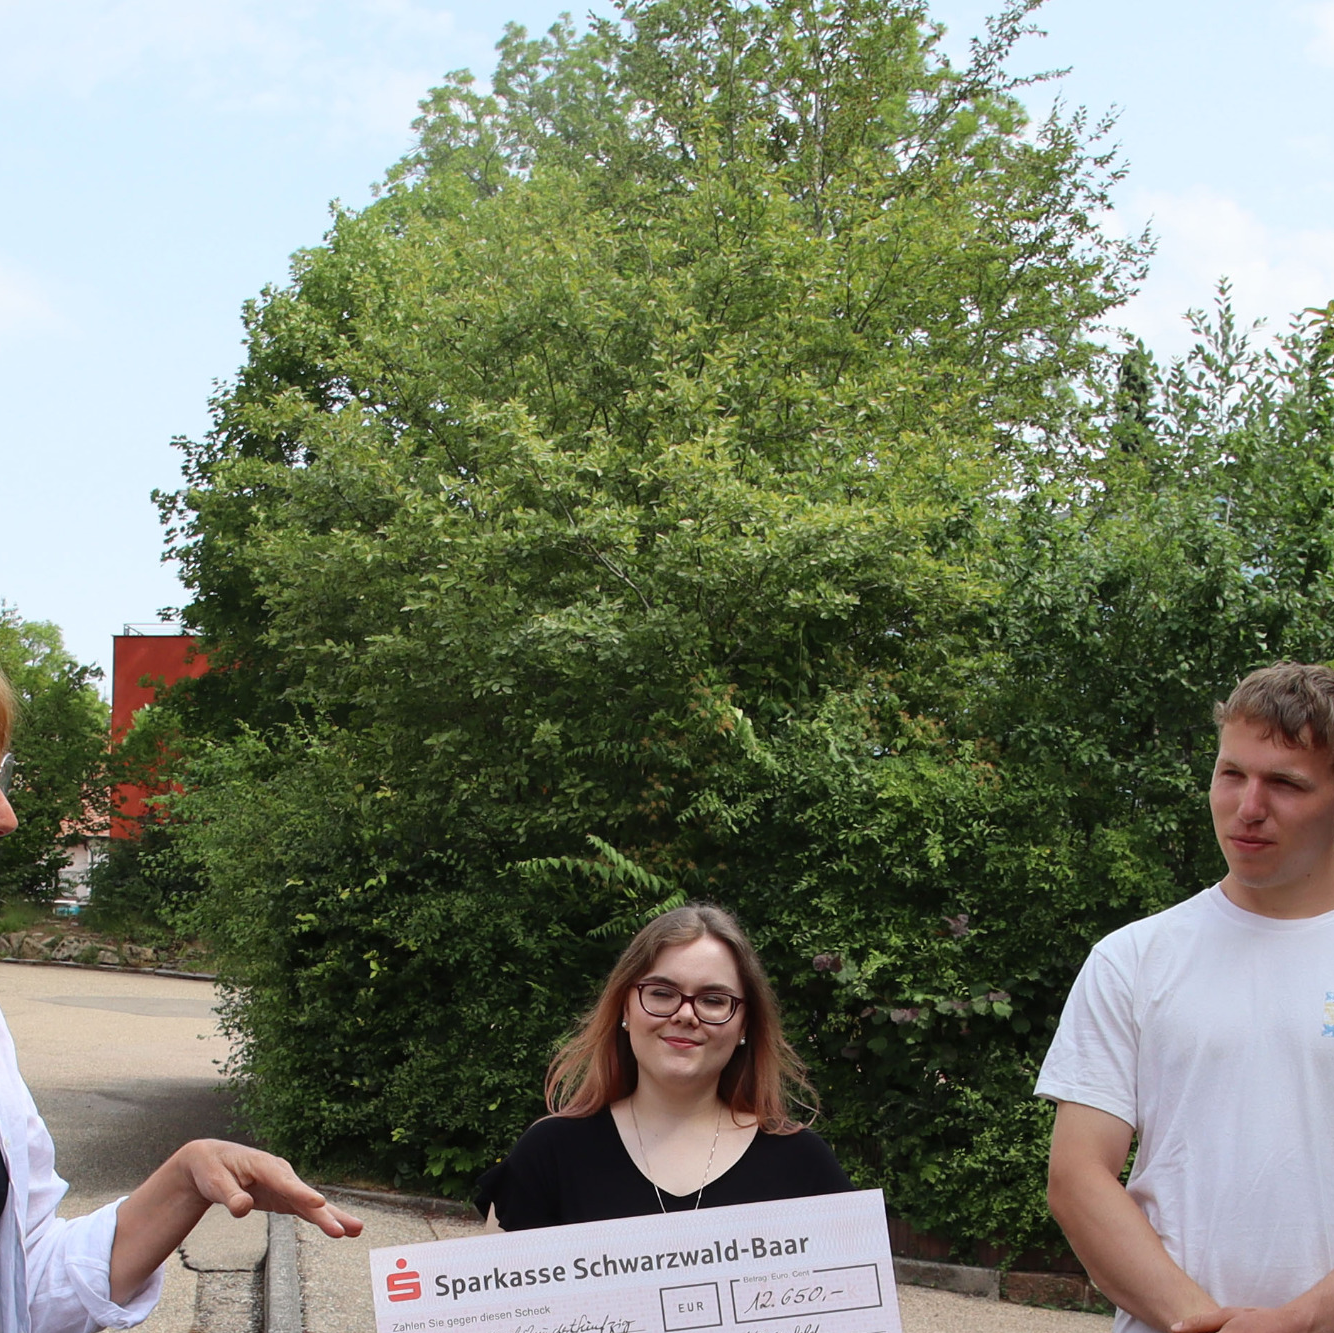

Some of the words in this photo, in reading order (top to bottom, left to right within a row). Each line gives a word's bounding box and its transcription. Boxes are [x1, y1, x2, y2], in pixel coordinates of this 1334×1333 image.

[434, 1265, 566, 1300] Sparkasse
[572, 1236, 809, 1279] Schwarzwald-Baar
[791, 1269, 810, 1278] Cent
[677, 1300, 704, 1313] EUR
[391, 1321, 426, 1332] Zahlen
[427, 1318, 444, 1328] Sie
[446, 1315, 477, 1328] gegen
[479, 1311, 512, 1322] diesen
[514, 1304, 551, 1317] Scheck
